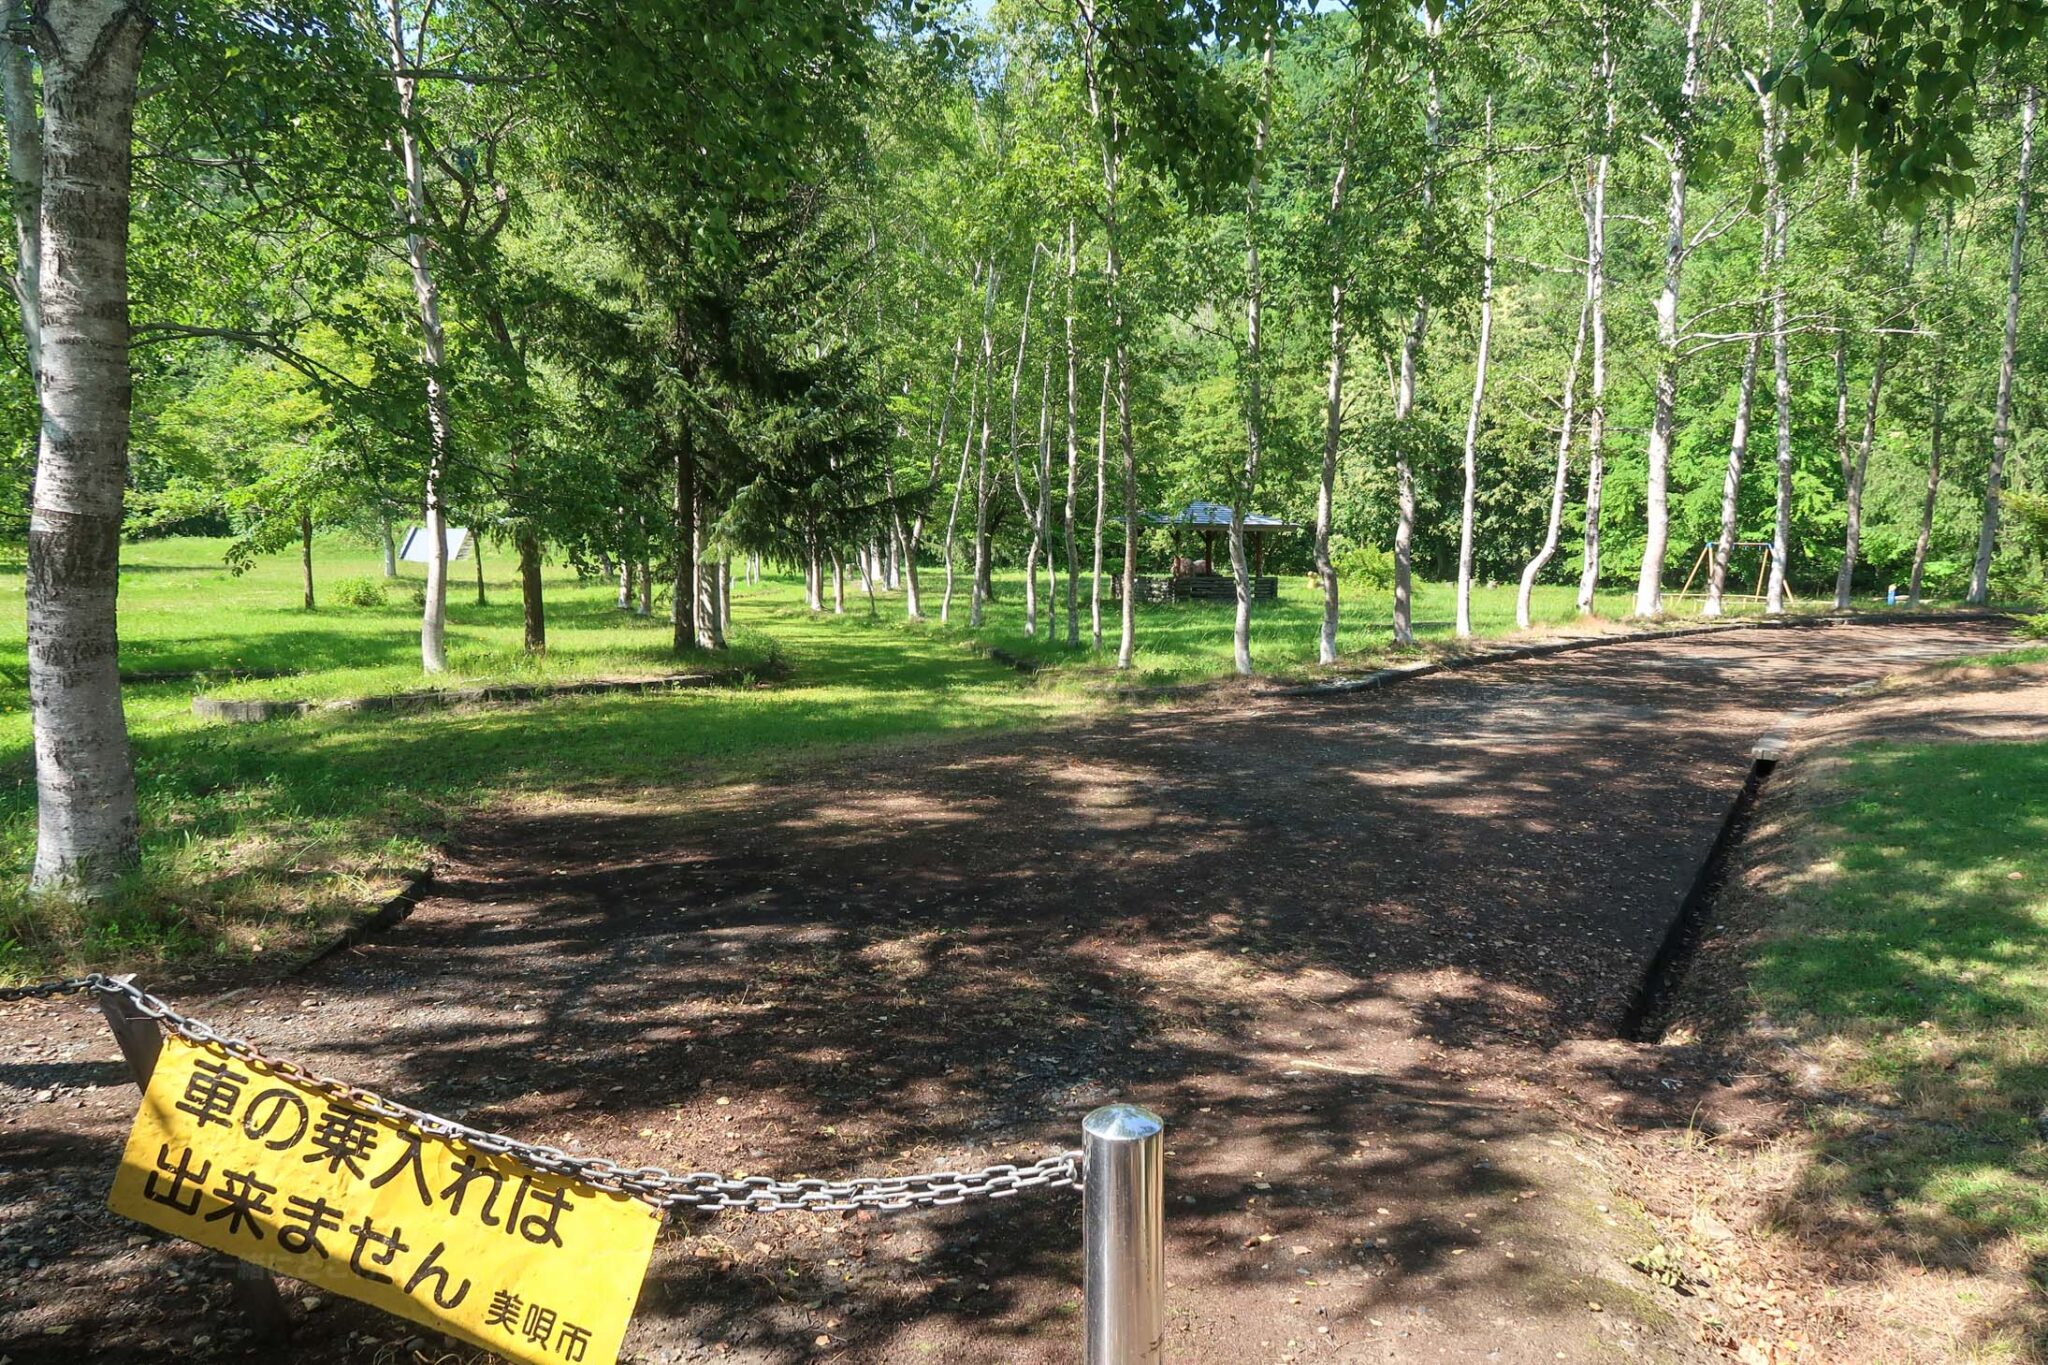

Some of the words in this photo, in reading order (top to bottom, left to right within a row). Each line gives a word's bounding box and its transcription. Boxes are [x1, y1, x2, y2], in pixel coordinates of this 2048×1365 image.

[144, 1143, 471, 1309] 出来ません
[175, 1058, 574, 1248] 車の乗入れは
[485, 1289, 592, 1362] 美唄市
